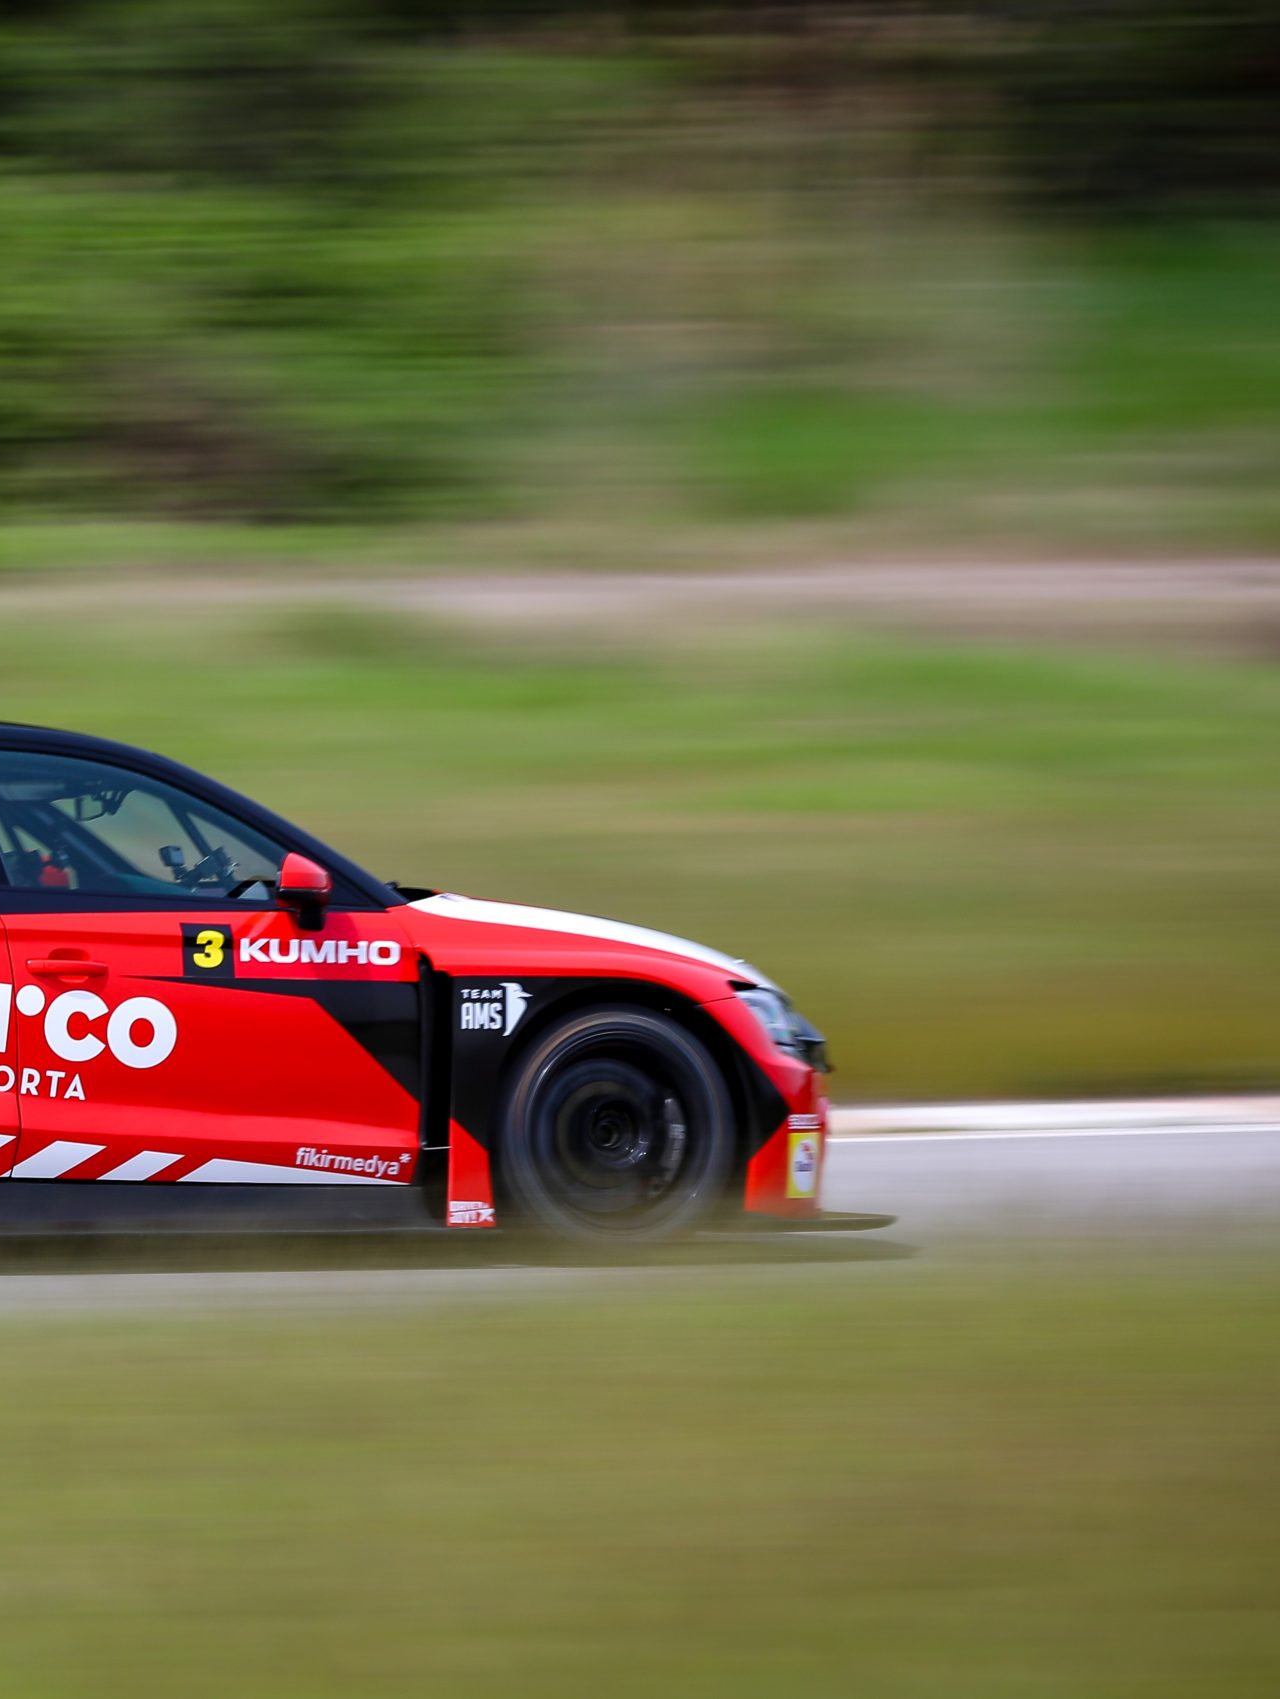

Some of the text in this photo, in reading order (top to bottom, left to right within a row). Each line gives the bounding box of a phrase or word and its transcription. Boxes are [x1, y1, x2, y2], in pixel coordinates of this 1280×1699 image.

[193, 930, 225, 969] 3
[239, 938, 401, 966] KUMHO
[460, 989, 503, 999] TEAM
[460, 1002, 503, 1030] AMS
